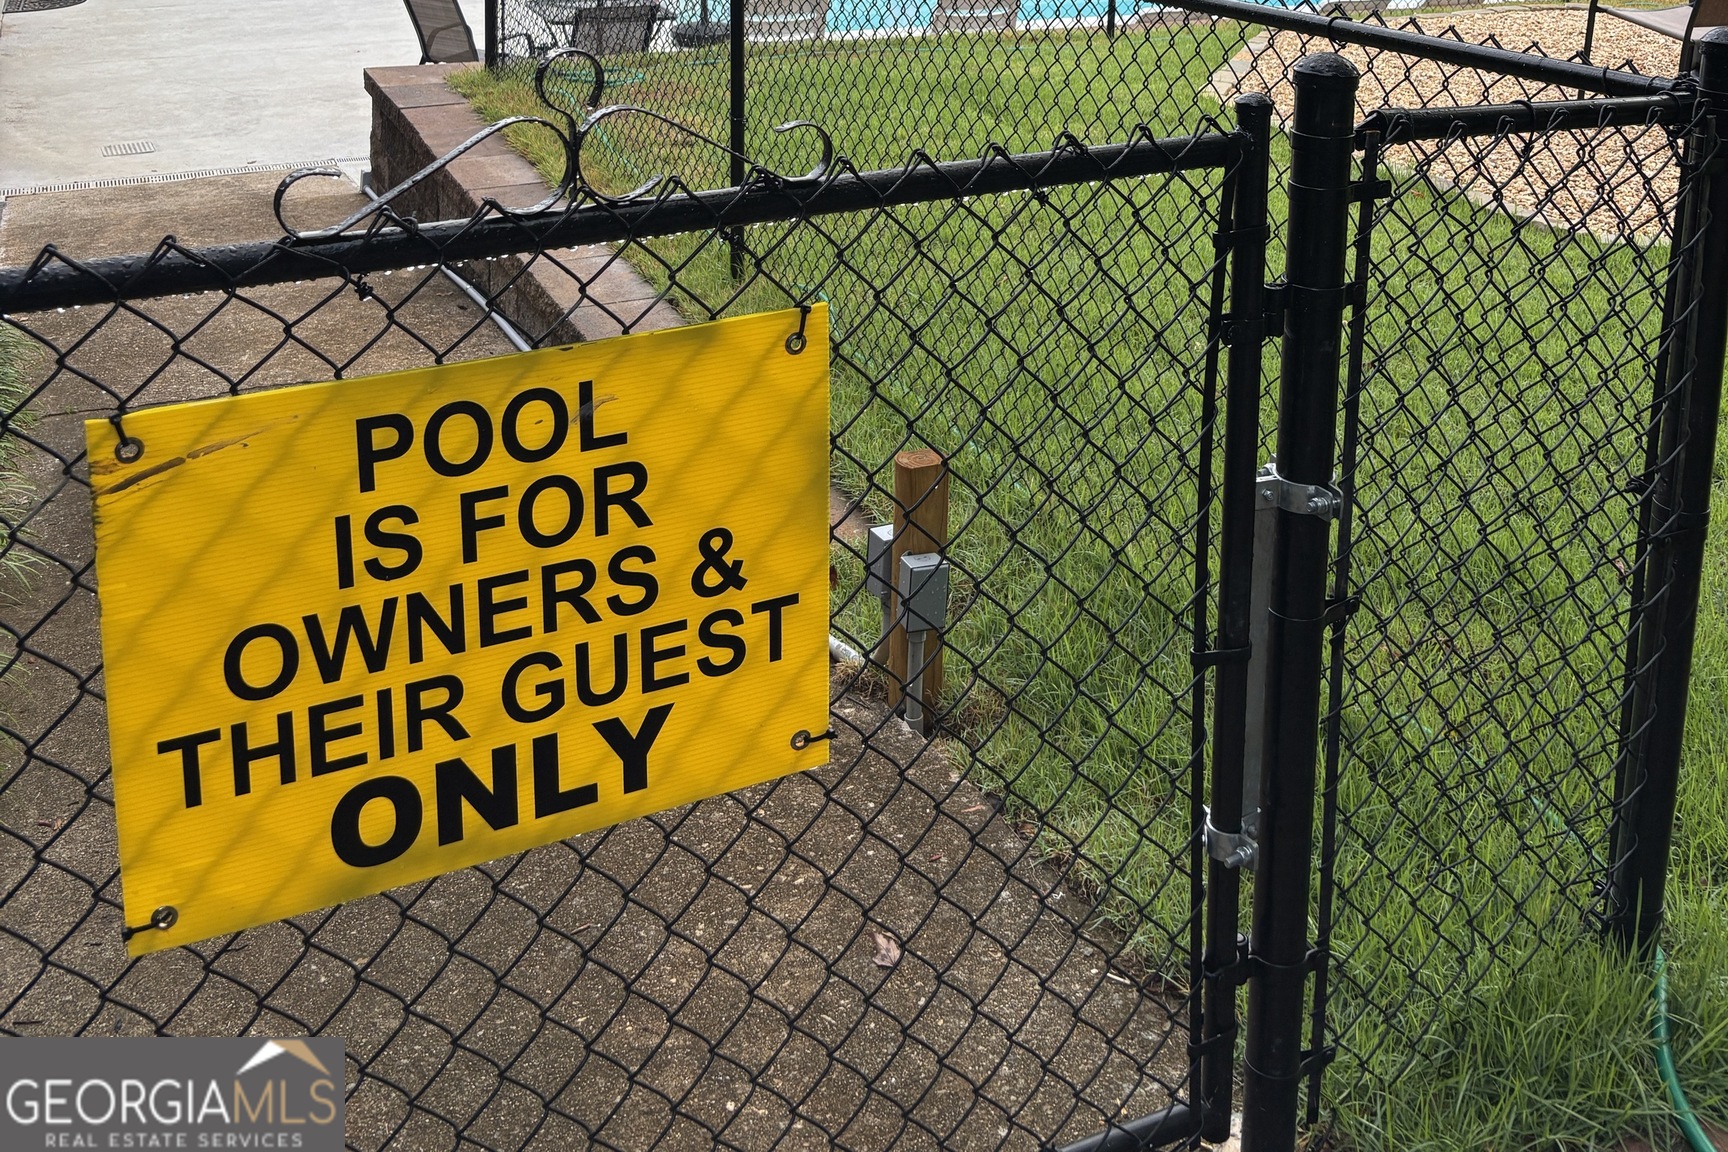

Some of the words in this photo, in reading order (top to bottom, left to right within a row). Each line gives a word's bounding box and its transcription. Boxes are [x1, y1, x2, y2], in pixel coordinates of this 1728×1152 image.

[355, 380, 628, 494] POOL
[334, 504, 423, 590] IS
[460, 461, 654, 565] FOR
[223, 545, 659, 701] OWNERS
[691, 527, 748, 598] &
[157, 674, 471, 809] THEIR
[501, 592, 800, 724] GUEST
[330, 702, 675, 868] ONLY
